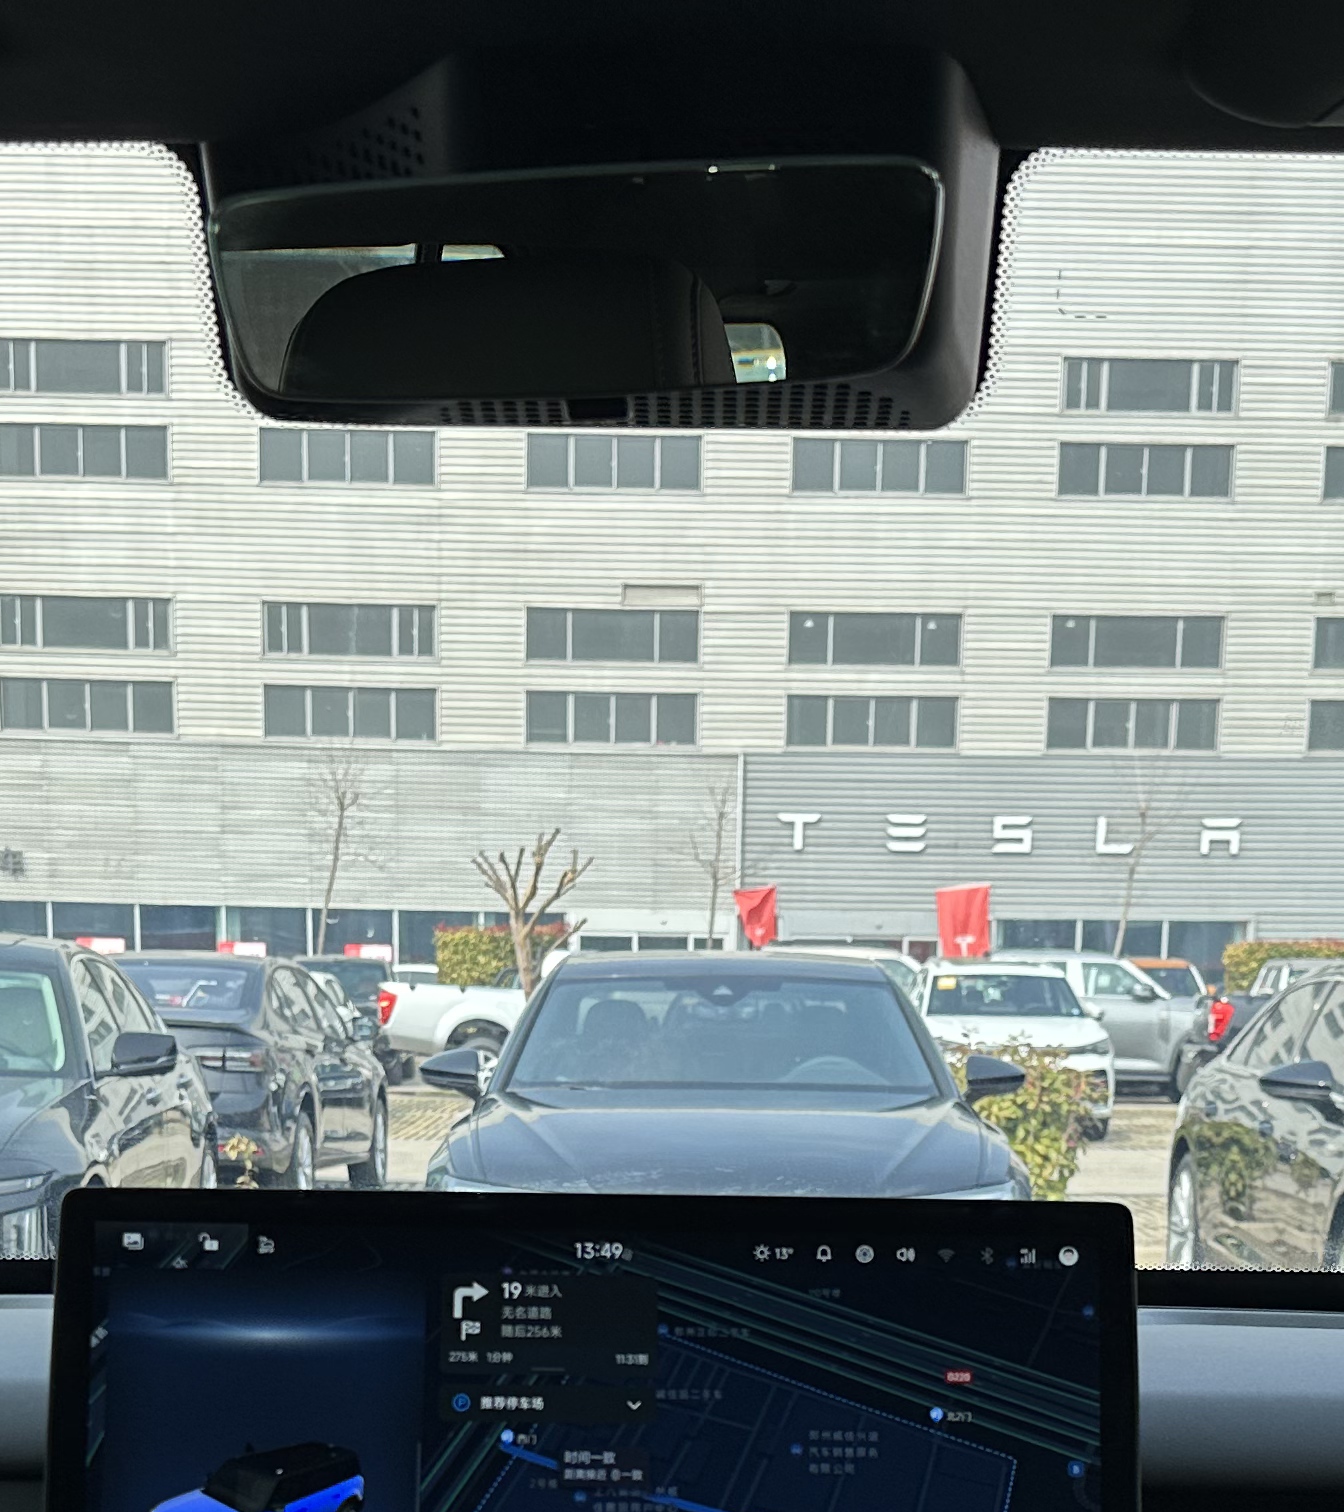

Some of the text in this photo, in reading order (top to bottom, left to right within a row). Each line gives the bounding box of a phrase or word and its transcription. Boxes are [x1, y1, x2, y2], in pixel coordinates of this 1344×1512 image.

[777, 811, 1243, 856] TESLA
[574, 1241, 624, 1260] 13:49
[501, 1281, 523, 1300] 19
[501, 1305, 553, 1320] 无名道路
[501, 1323, 563, 1339] 随后256米
[479, 1395, 545, 1411] 推荐停车场
